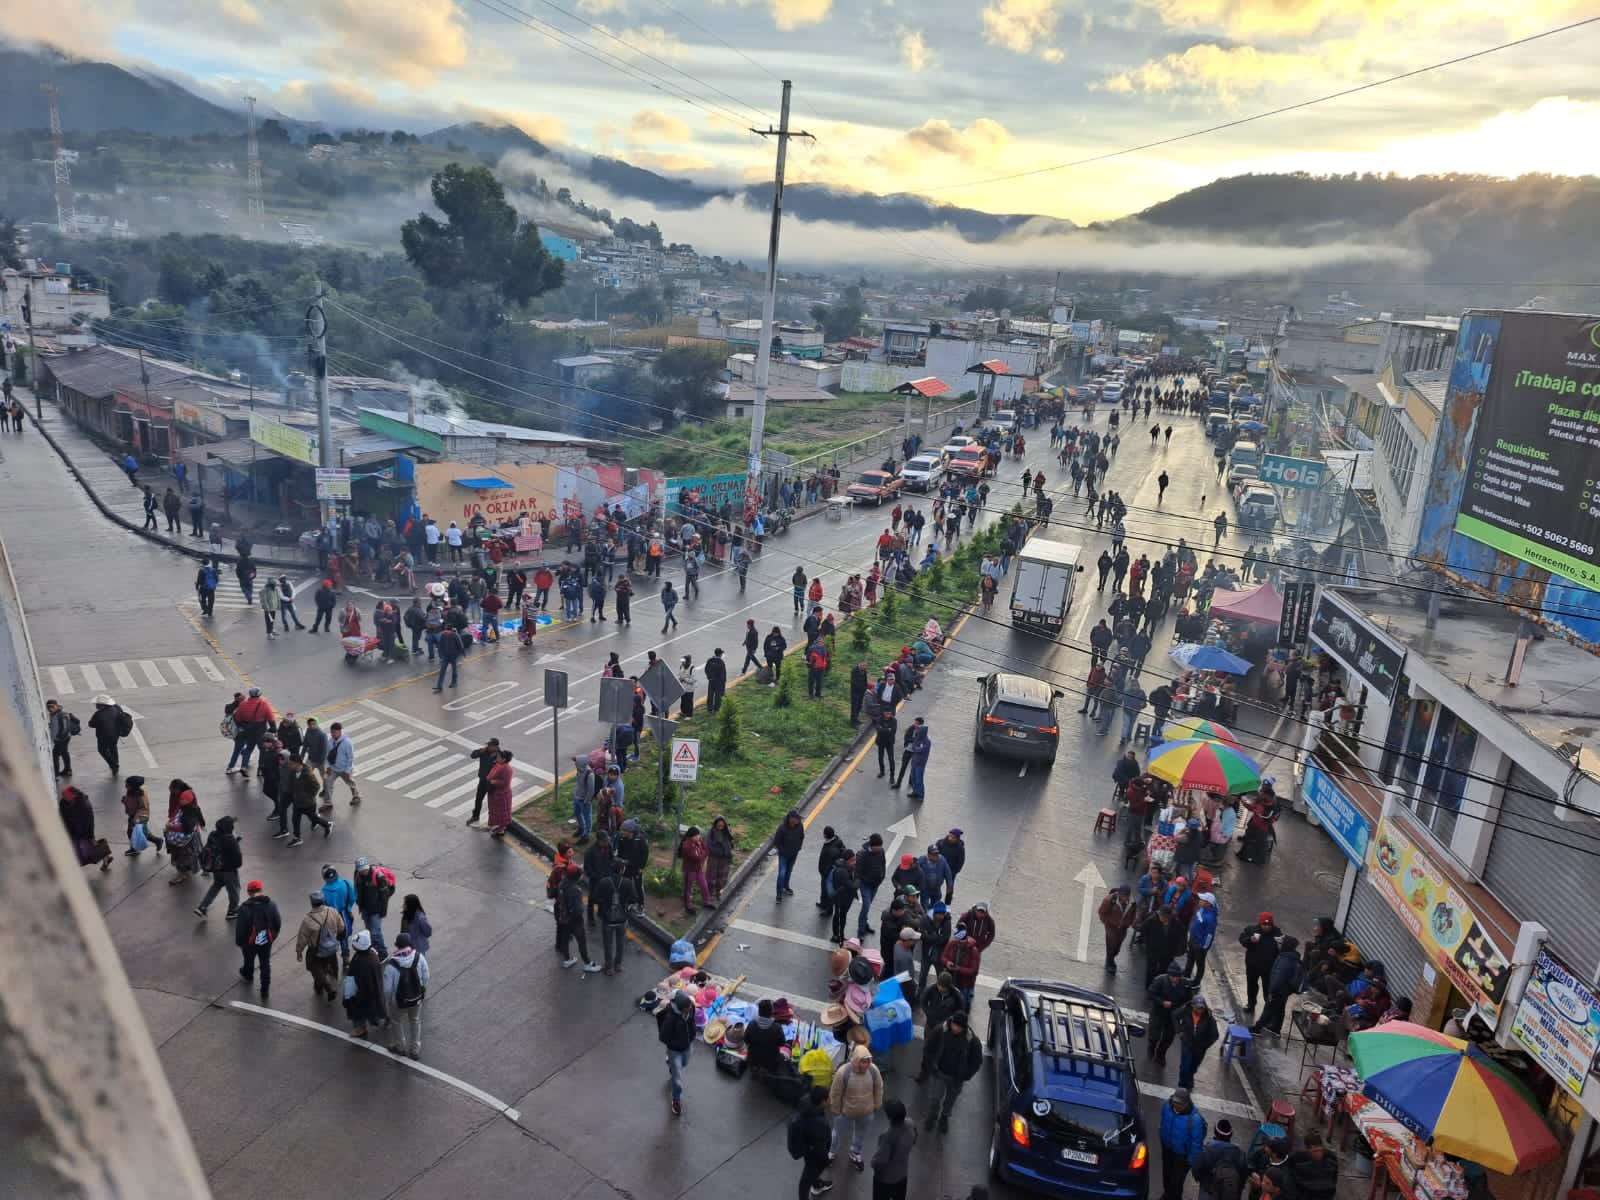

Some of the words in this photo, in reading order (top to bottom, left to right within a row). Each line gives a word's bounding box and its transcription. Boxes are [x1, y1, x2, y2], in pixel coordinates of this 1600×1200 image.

[1567, 351, 1597, 361] MAX
[1514, 370, 1577, 395] ¡Trabaja
[1548, 403, 1580, 418] Plazas
[1548, 428, 1574, 440] Piloto
[1575, 434, 1587, 443] de
[1550, 418, 1584, 431] Auxiliar
[1586, 424, 1598, 434] de
[1496, 438, 1550, 461] Requisitos:
[1263, 460, 1320, 485] Hola
[463, 503, 480, 518] NO
[486, 498, 537, 514] ORINAR
[1522, 522, 1543, 537] +502
[1544, 530, 1568, 546] 5062
[1569, 539, 1594, 556] 5669
[1524, 547, 1578, 577] Herracentro,
[1579, 570, 1599, 585] S.A.
[1283, 590, 1295, 637] TATTOO
[1538, 949, 1574, 988] Servicio
[1540, 1017, 1569, 1049] MEDICINA
[1375, 1093, 1422, 1133] DIRECT
